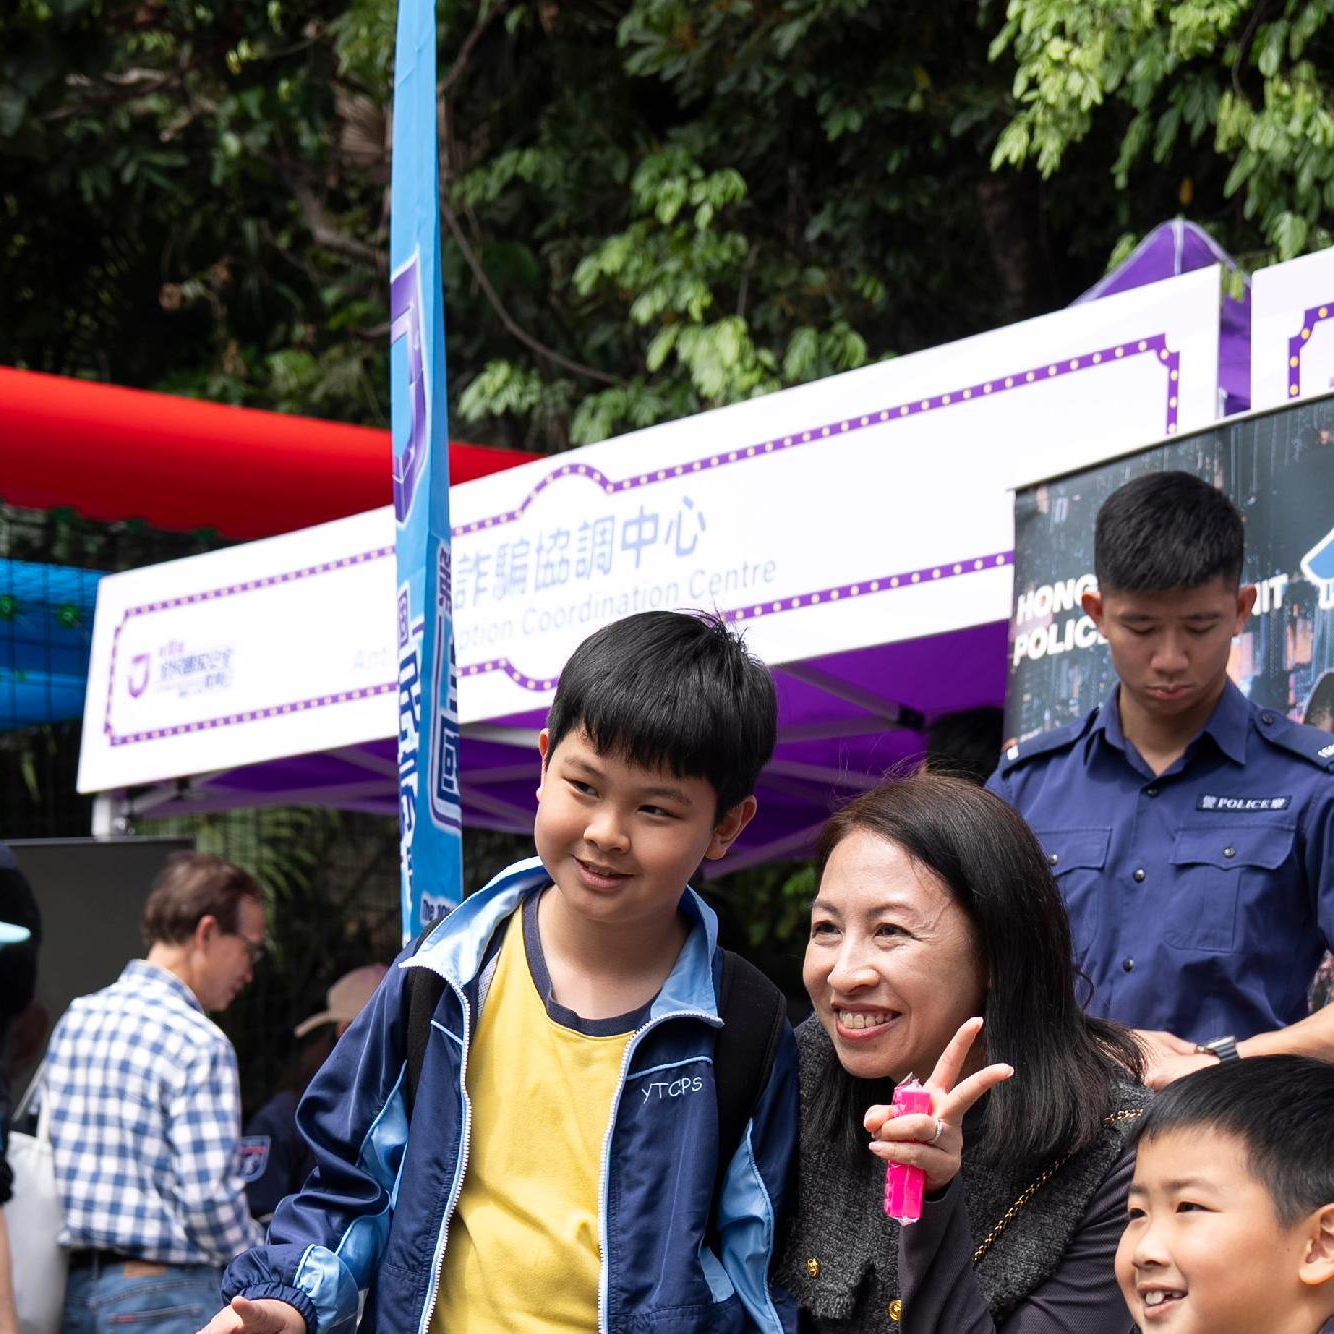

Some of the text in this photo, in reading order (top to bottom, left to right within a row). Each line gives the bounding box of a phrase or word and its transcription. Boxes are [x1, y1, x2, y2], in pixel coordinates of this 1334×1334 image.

[454, 495, 707, 611] 詐騙協調中心
[521, 578, 680, 637] Coordination
[689, 559, 778, 601] Centre
[1013, 615, 1108, 666] POLIC
[641, 1076, 703, 1104] YTCPS
